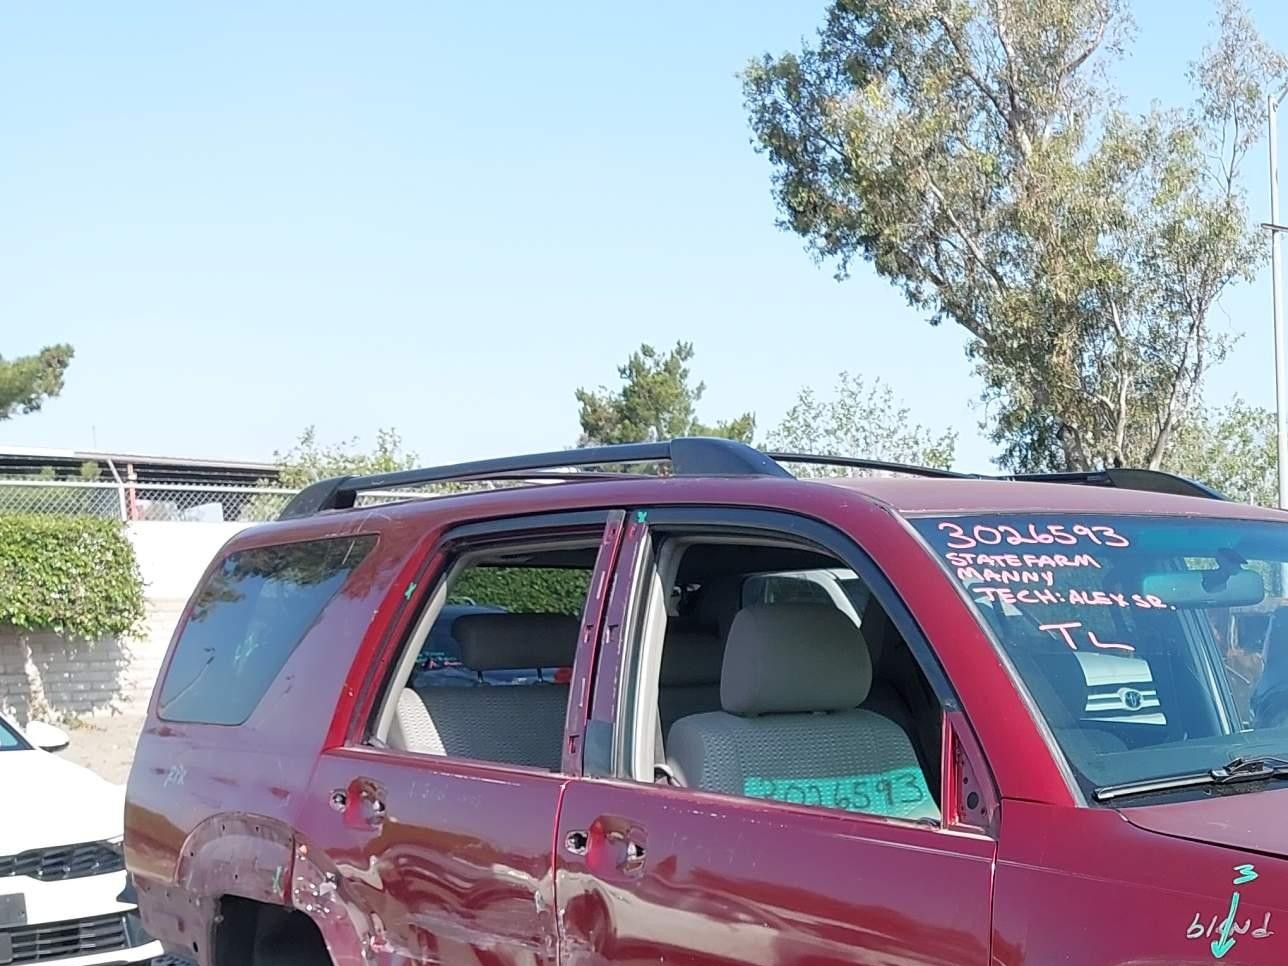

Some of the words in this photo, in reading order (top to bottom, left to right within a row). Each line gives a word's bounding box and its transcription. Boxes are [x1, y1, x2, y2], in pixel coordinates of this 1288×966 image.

[938, 521, 1130, 549] 3026593
[957, 566, 1054, 586] MANNY
[973, 586, 1066, 605] TECH:
[1068, 588, 1129, 608] ALEX
[1232, 863, 1259, 885] 3
